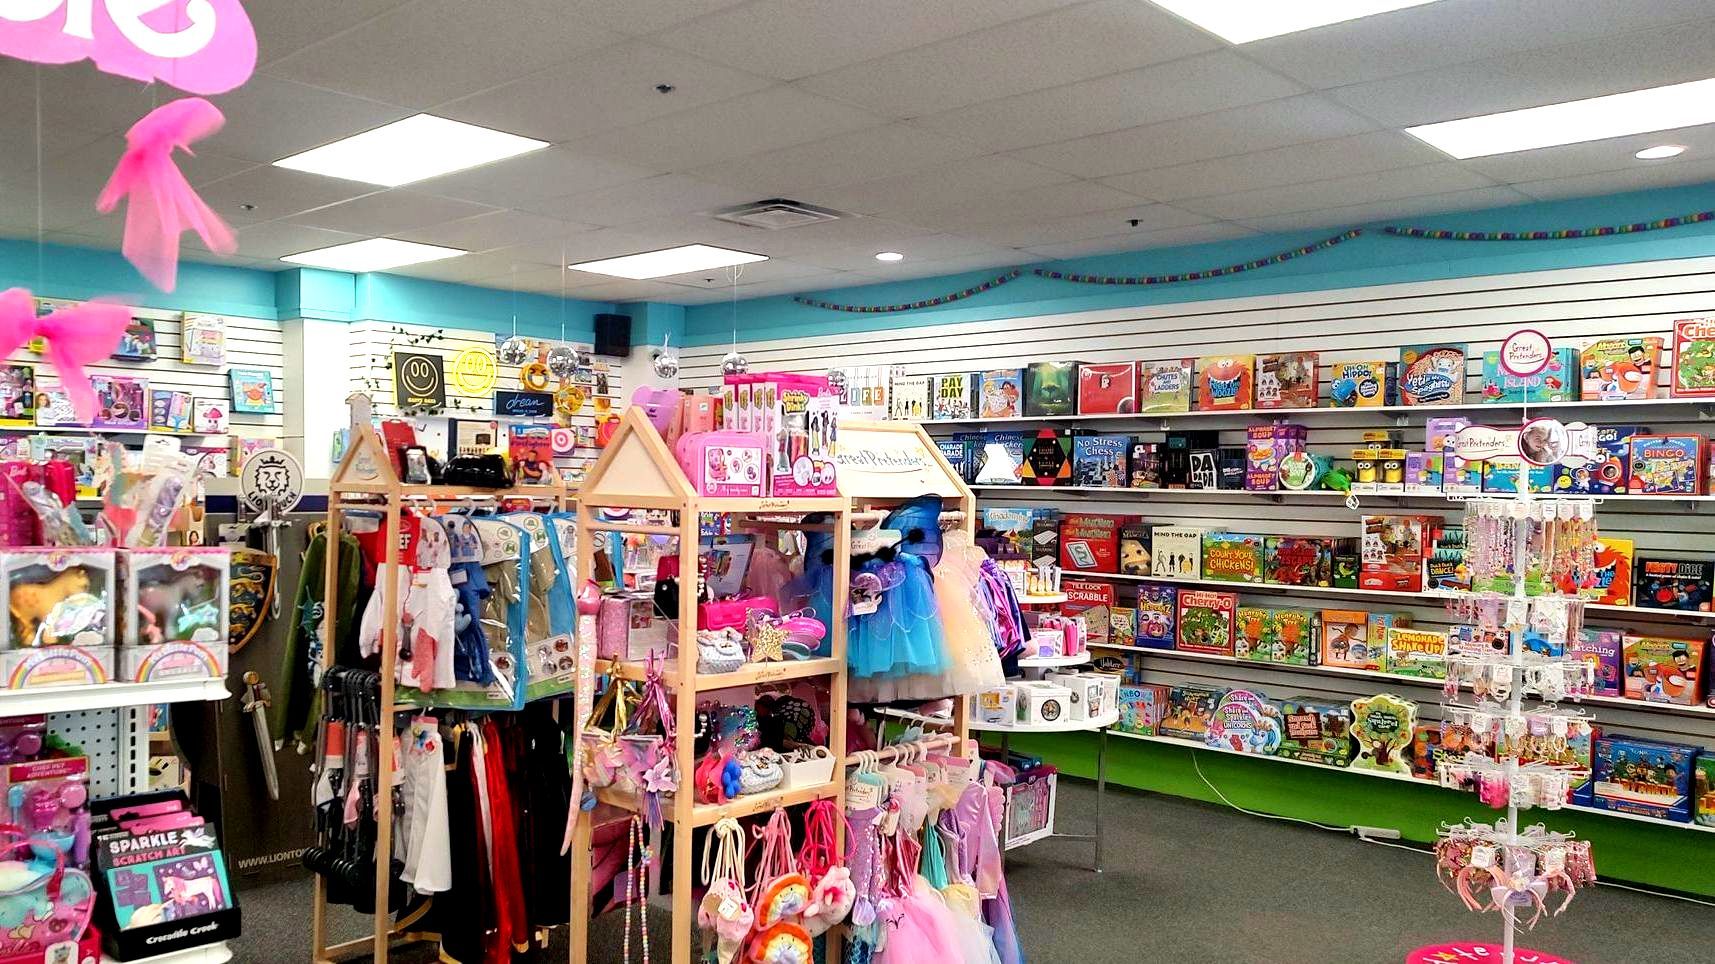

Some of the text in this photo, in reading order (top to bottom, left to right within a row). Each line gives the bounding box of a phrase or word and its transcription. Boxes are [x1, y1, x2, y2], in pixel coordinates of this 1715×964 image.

[1511, 342, 1532, 353] Great
[1508, 350, 1542, 361] Pretenders
[941, 376, 963, 388] PAY
[1407, 373, 1425, 387] Yeti
[1504, 376, 1541, 388] ISLND
[940, 387, 963, 399] DAY
[1154, 383, 1179, 391] LADDERS
[1253, 431, 1272, 439] SOUP
[1093, 436, 1123, 448] Stress
[1085, 446, 1113, 456] Chess
[1644, 448, 1684, 459] BINGO
[1251, 478, 1271, 486] SOUP
[1209, 549, 1233, 559] COUNT
[1209, 558, 1254, 571] CHICKENS!
[1067, 590, 1109, 602] SCRABBLE
[1183, 595, 1232, 609] Cherry-O
[1396, 631, 1444, 642] LEMONADE
[1425, 641, 1444, 656] UP!
[1224, 706, 1242, 715] Share
[109, 830, 178, 854] SPARKLE
[112, 846, 186, 867] SCRATCH ART
[238, 848, 305, 869] WWW.LIONTO
[145, 921, 220, 945] Crocodile Creek
